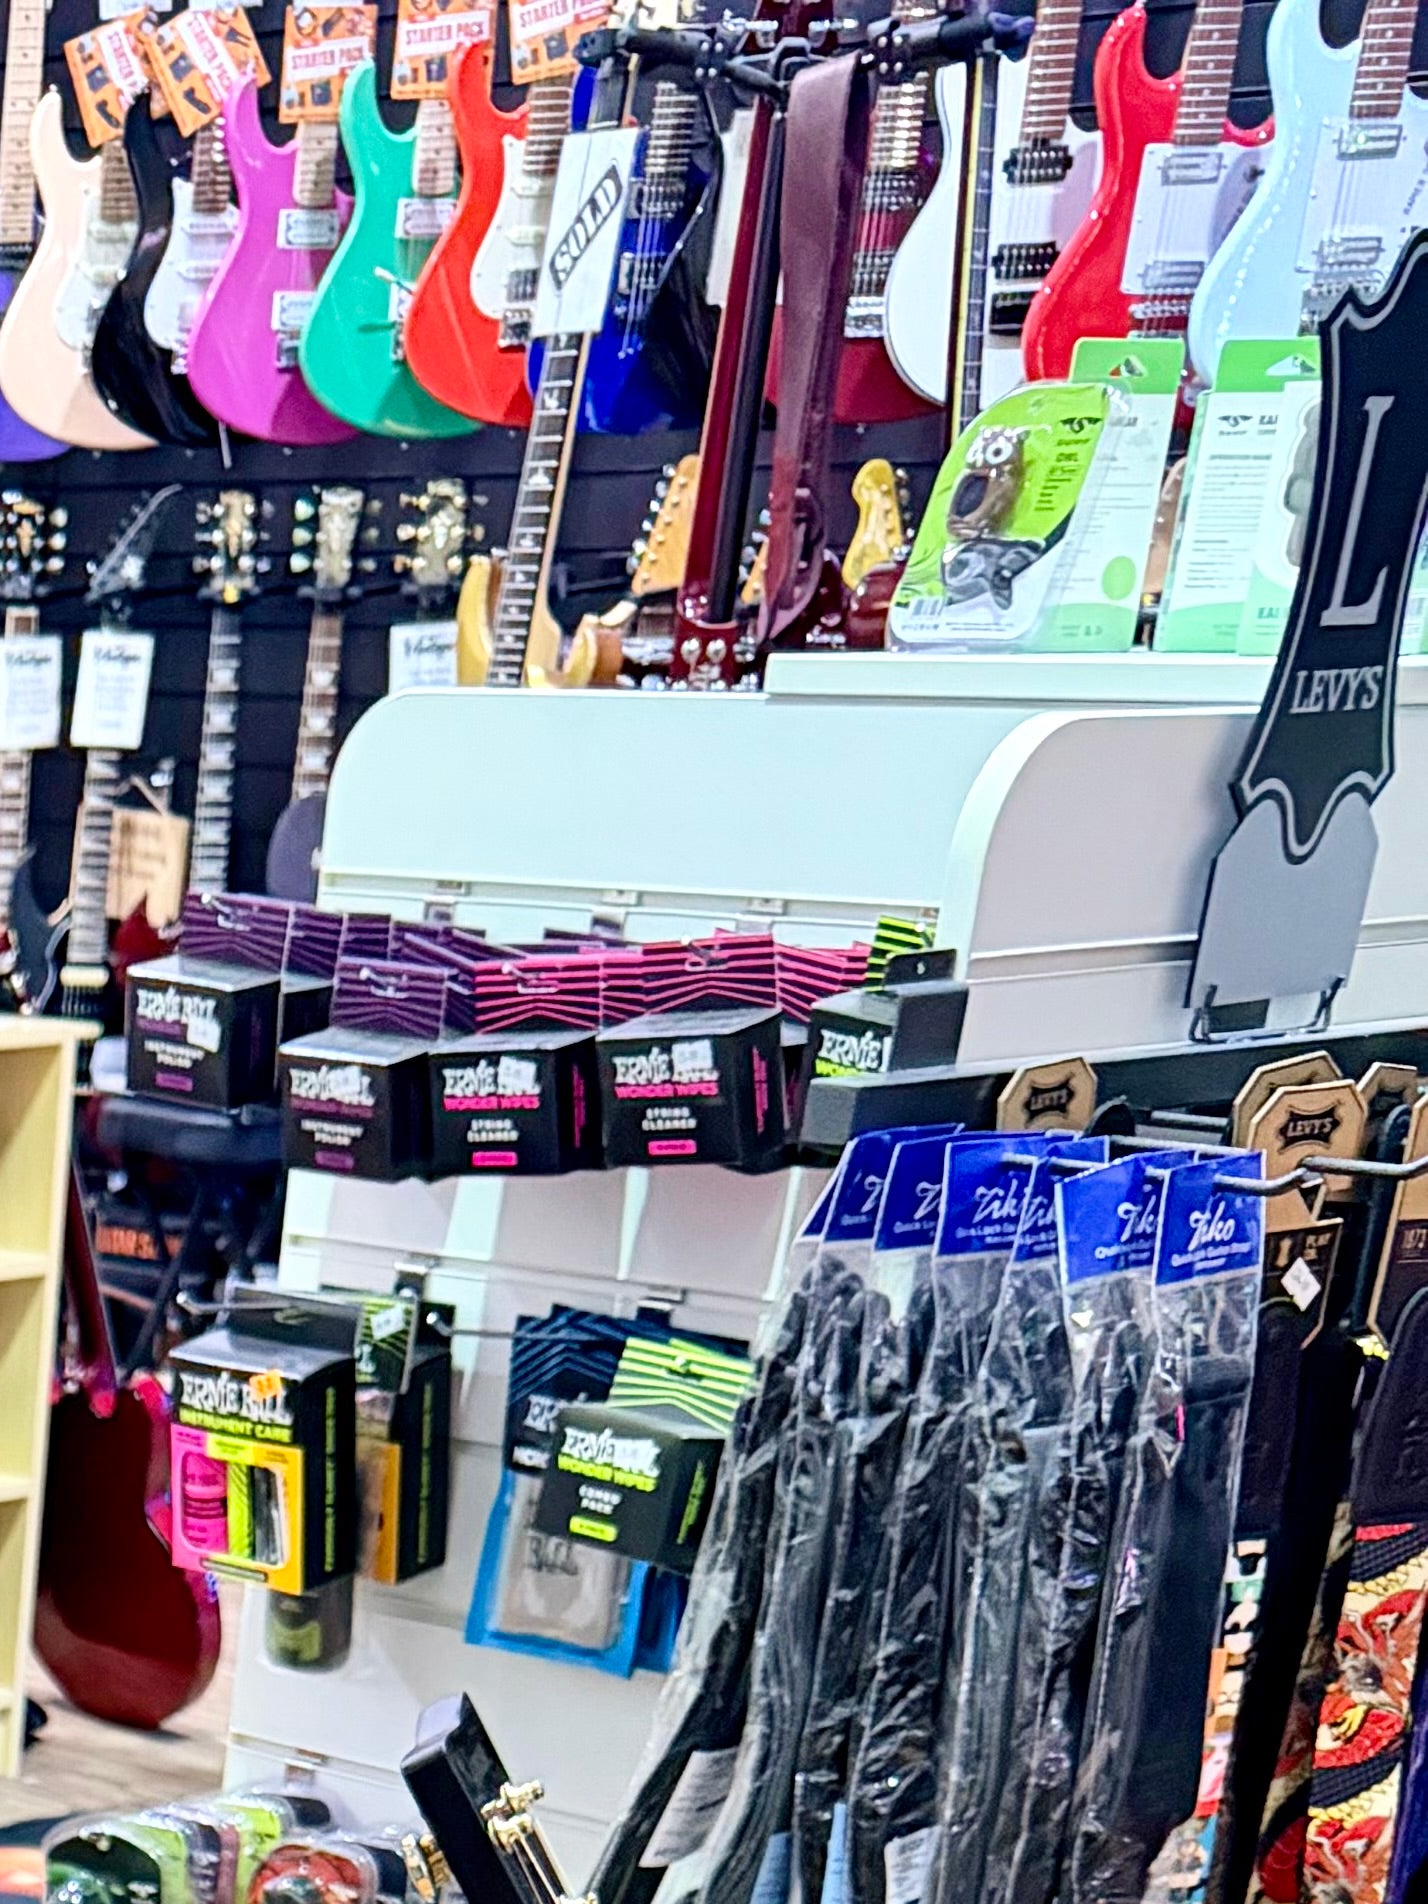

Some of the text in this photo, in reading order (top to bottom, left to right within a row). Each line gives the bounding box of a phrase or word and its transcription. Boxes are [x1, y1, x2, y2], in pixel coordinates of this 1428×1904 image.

[552, 170, 620, 286] SOLD
[1289, 665, 1385, 717] LEVY'S
[1287, 1117, 1334, 1138] LEVY'S
[179, 1370, 240, 1416] ERNIE
